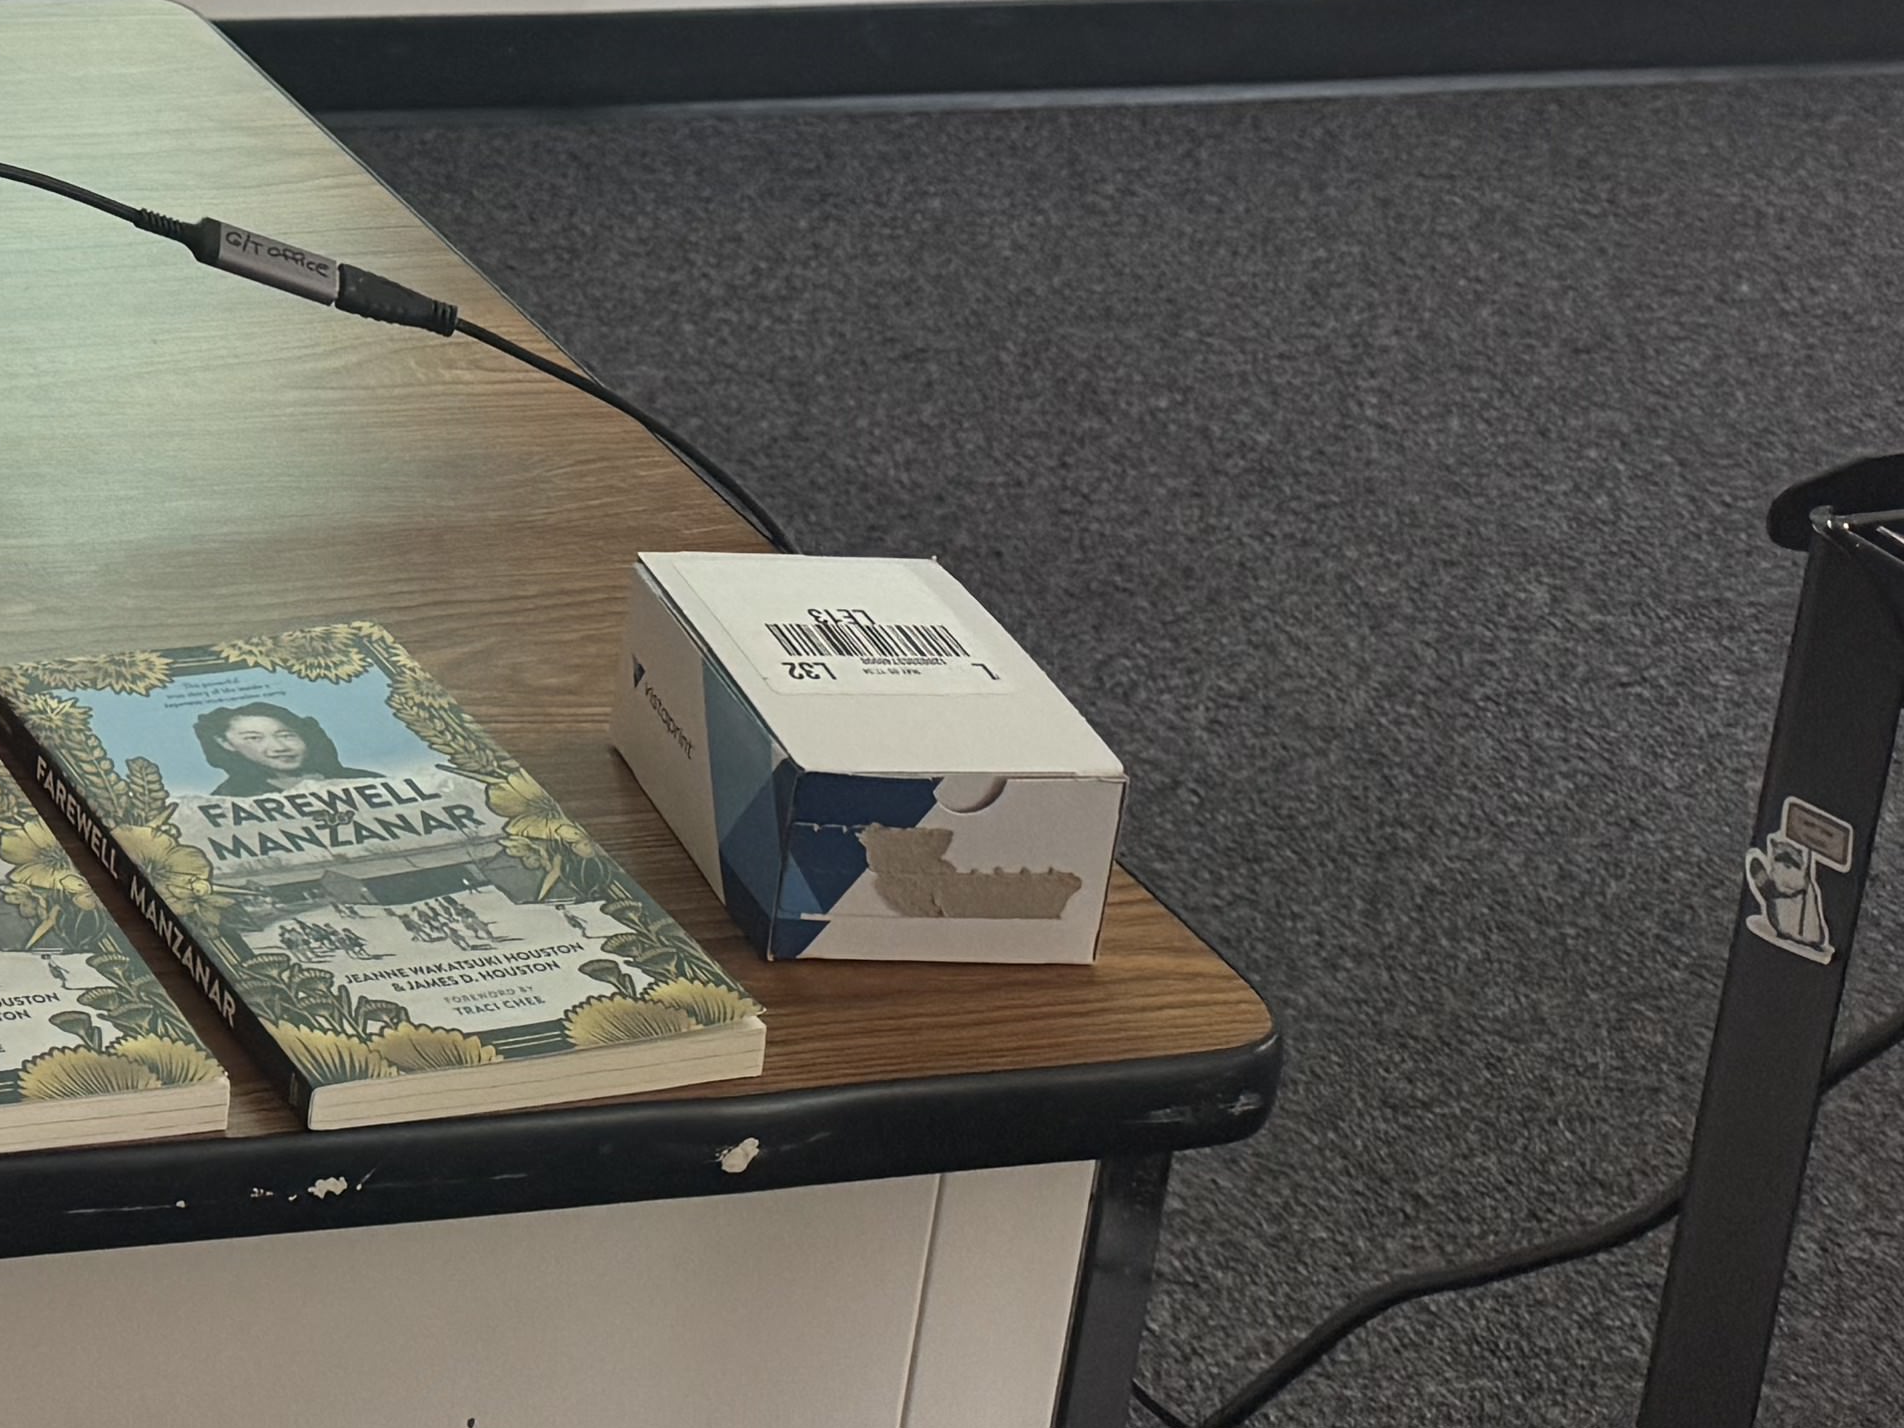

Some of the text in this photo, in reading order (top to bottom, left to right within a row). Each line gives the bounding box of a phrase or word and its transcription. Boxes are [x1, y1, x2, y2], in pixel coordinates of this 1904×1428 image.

[781, 662, 838, 680] L32
[644, 681, 694, 760] vistaprint
[197, 778, 443, 828] FAREWELL
[208, 803, 487, 861] MANZANAR
[34, 754, 238, 1029] FAREWELL MANZANAR
[345, 942, 585, 985] JEANNE WAKATSUKI HOUSTON
[392, 960, 561, 993] & JAMES D. HOUSTON
[453, 996, 546, 1017] TRACI CHEE
